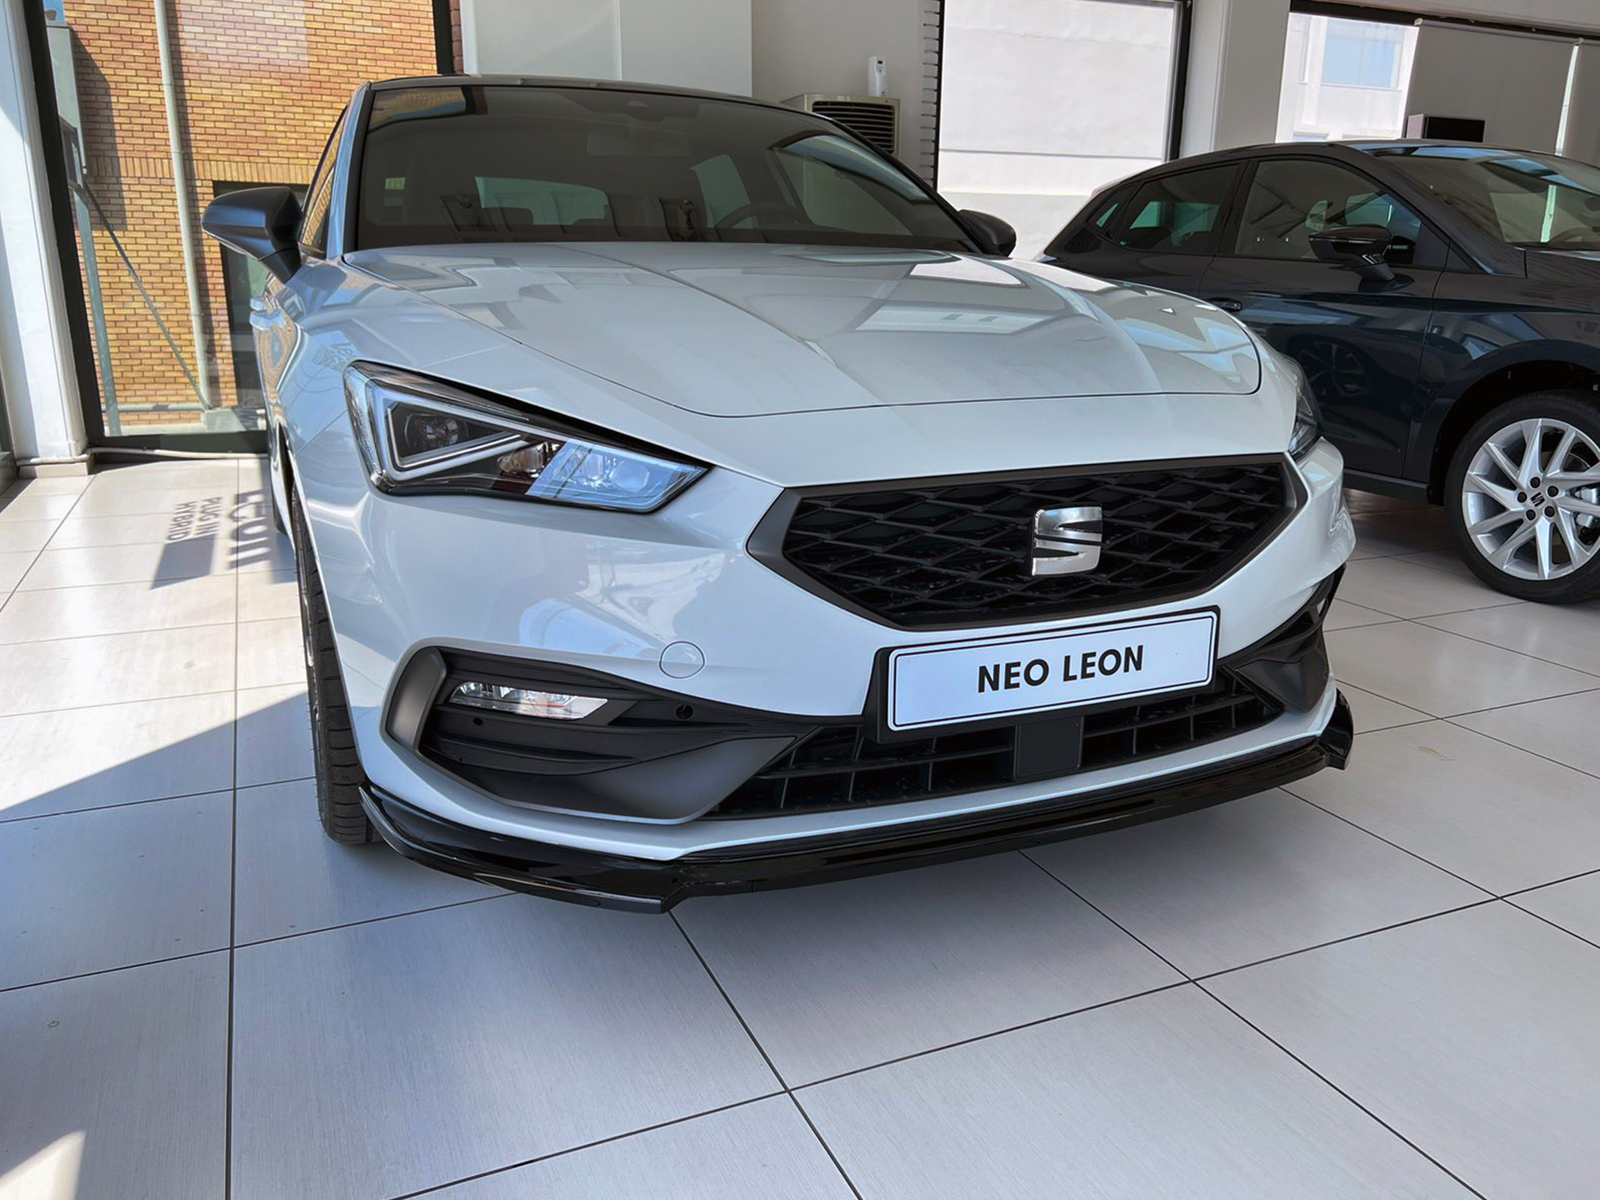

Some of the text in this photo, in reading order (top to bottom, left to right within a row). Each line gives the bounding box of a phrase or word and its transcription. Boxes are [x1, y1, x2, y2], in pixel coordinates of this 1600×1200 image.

[166, 501, 197, 541] HYBRID
[977, 645, 1144, 693] NEO LEON
